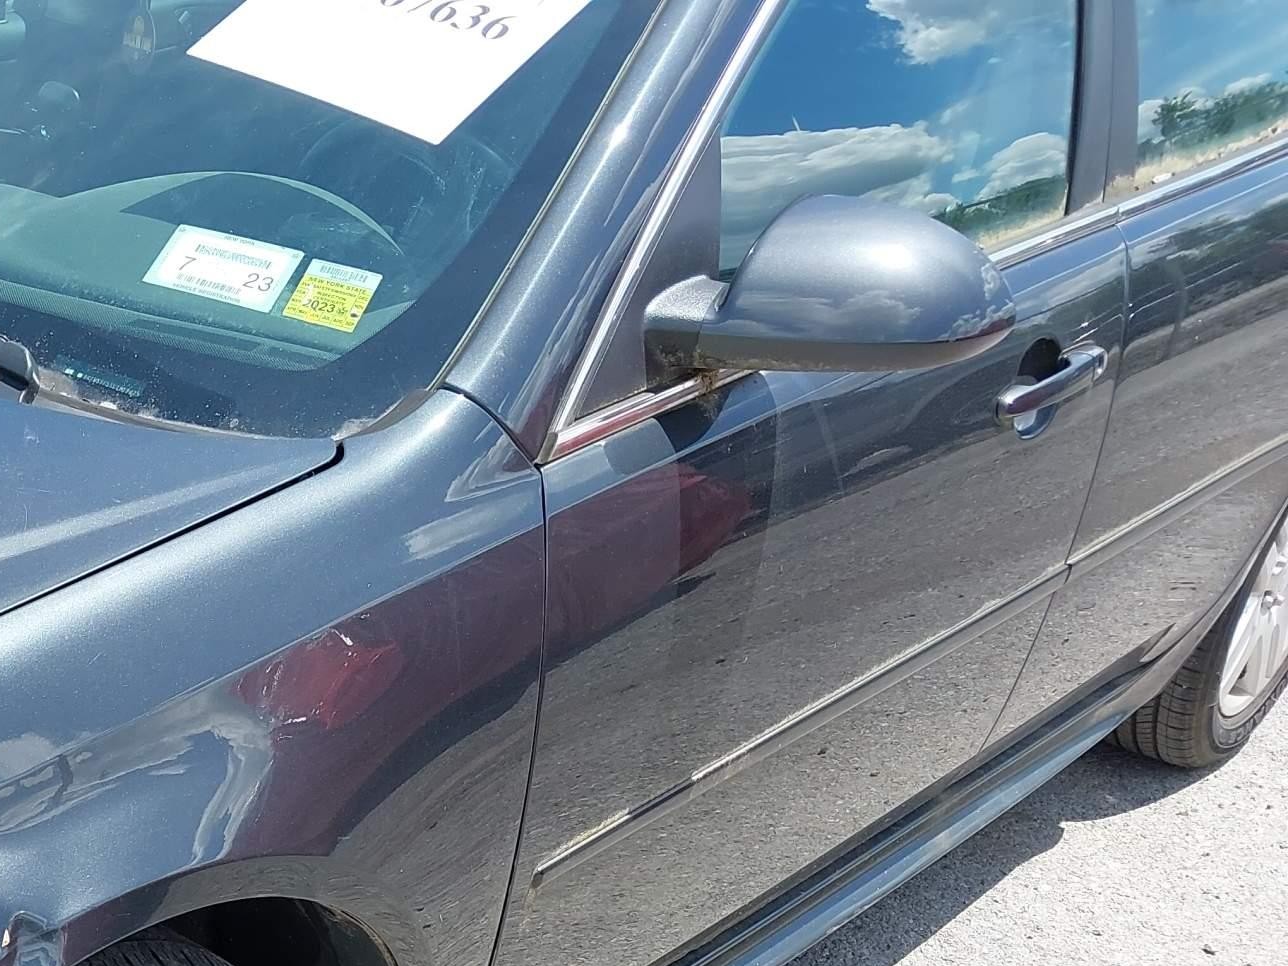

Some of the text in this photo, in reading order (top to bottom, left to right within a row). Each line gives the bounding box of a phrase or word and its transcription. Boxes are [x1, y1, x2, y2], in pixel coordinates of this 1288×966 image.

[179, 255, 274, 292] 7 23
[326, 280, 344, 288] YORK
[346, 284, 367, 294] STATE
[302, 299, 336, 313] 2023
